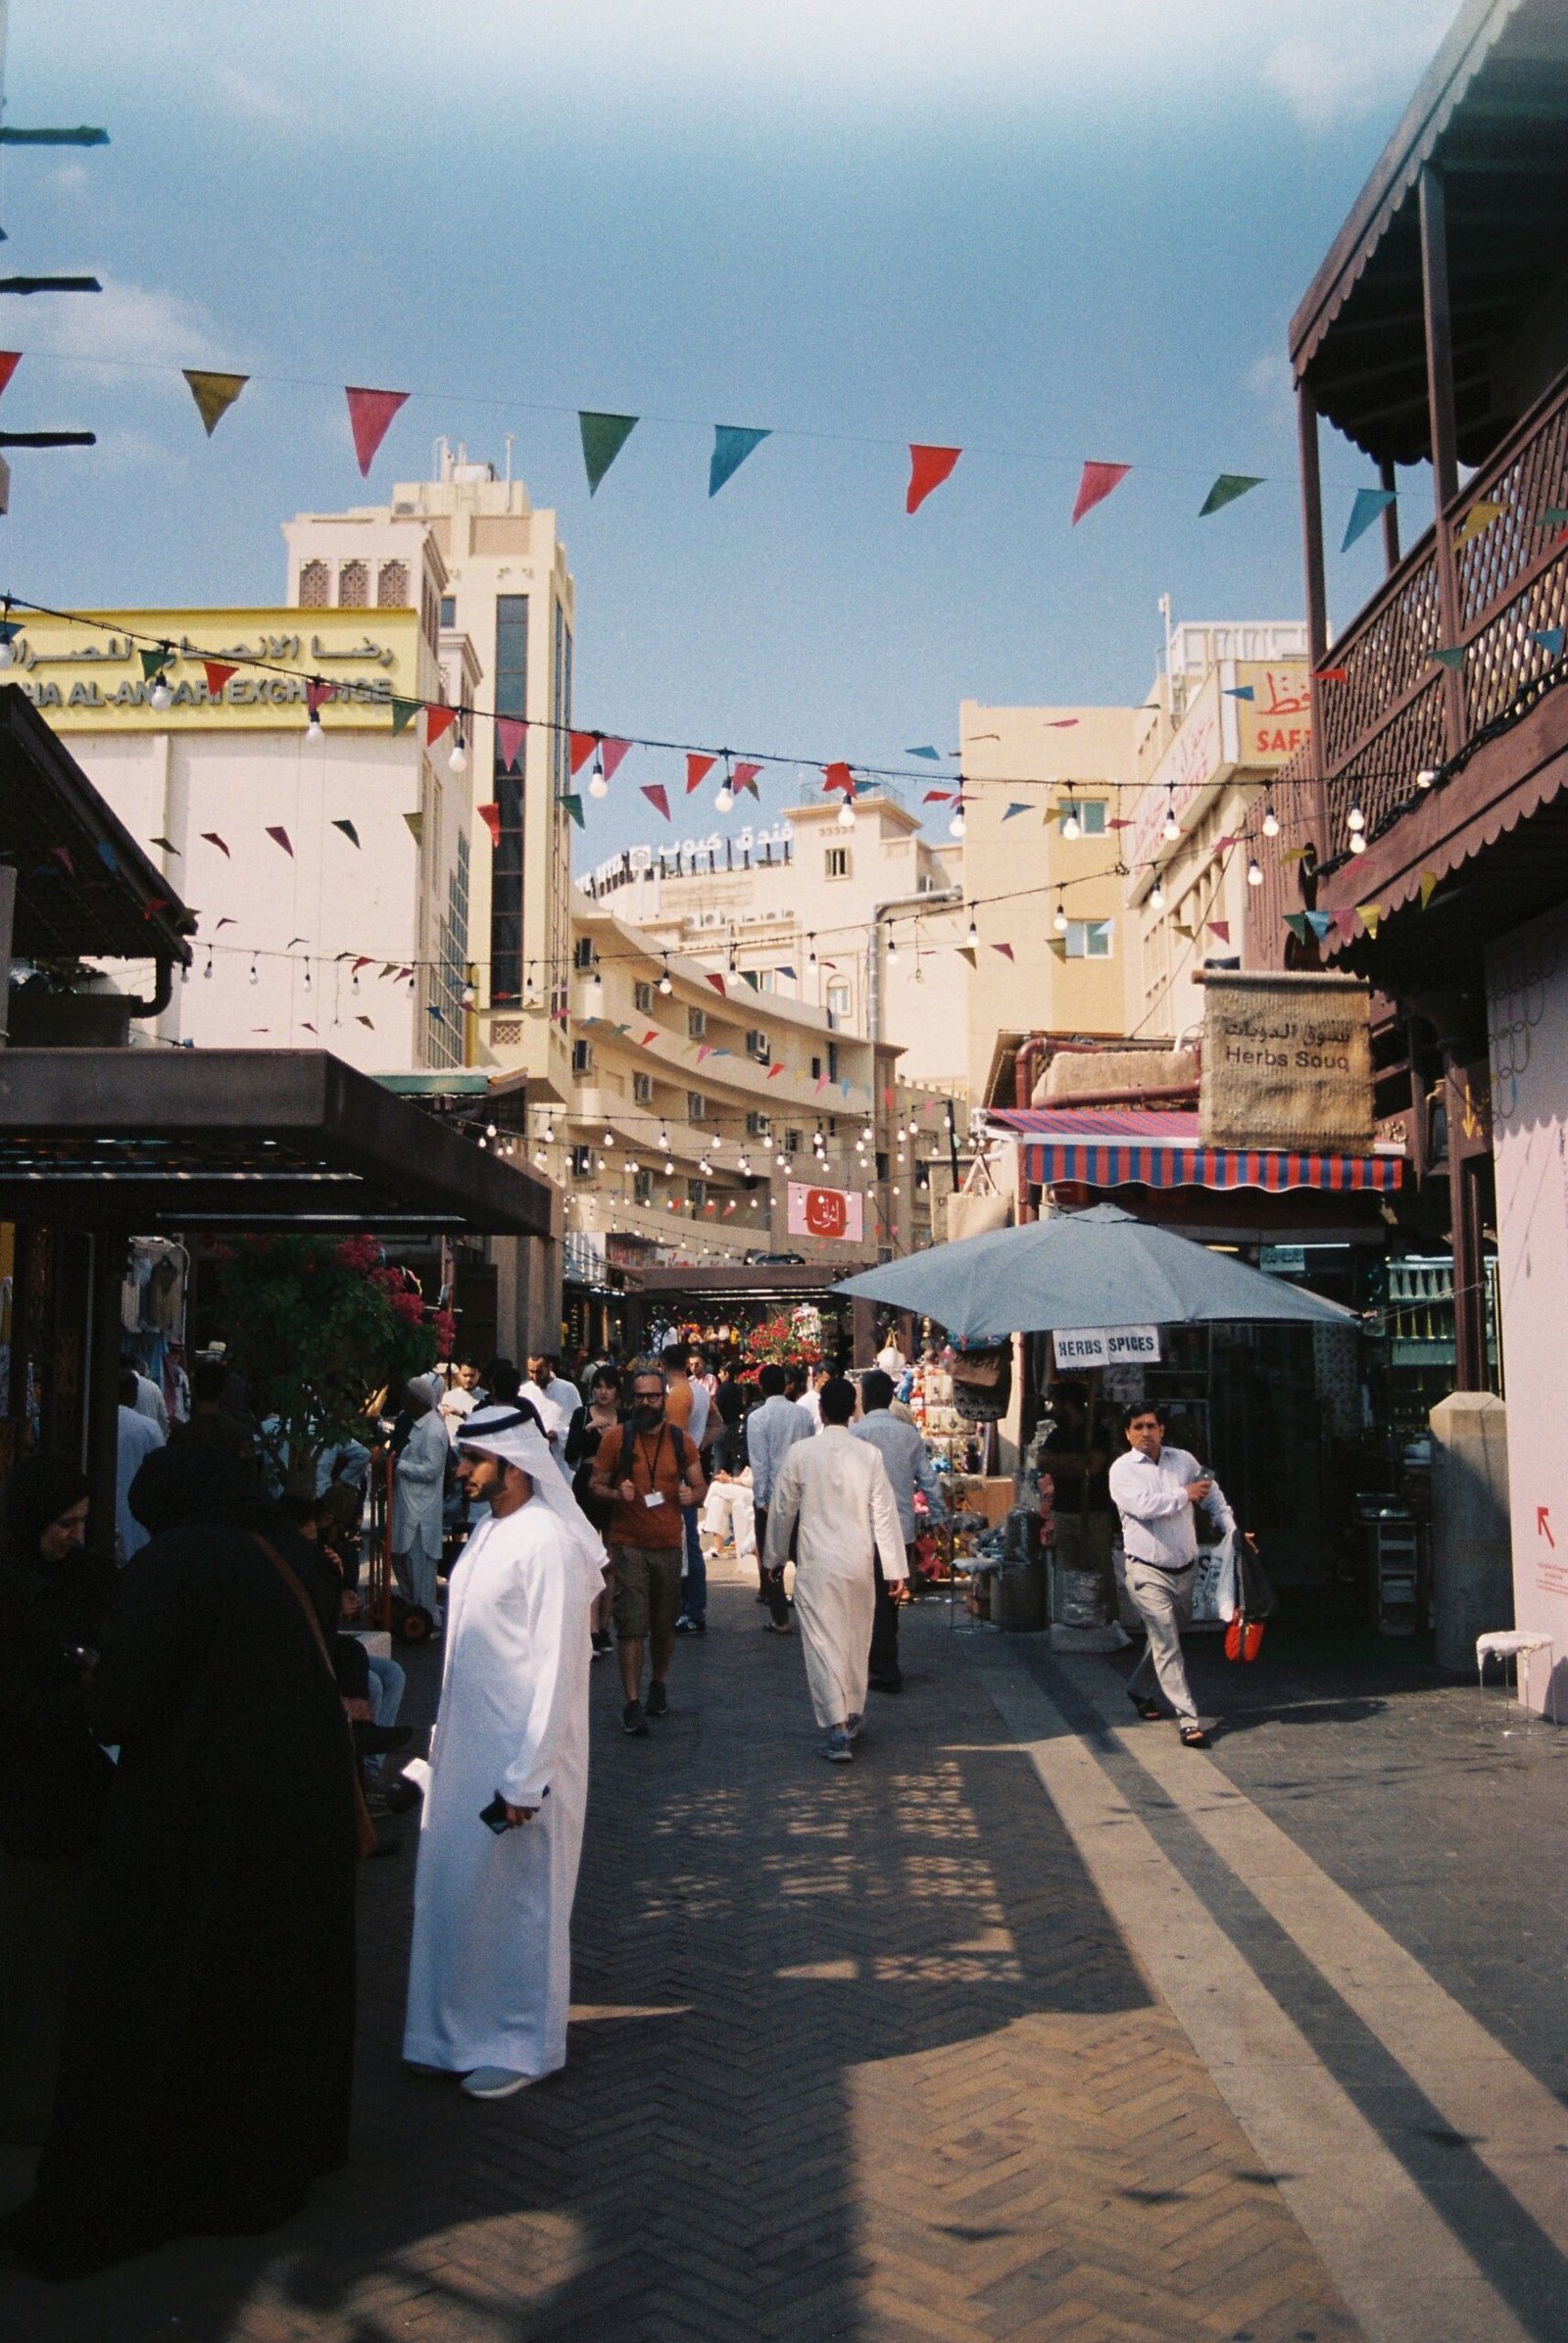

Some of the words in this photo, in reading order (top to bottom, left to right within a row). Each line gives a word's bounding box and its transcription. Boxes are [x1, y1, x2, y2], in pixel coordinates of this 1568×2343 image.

[311, 635, 393, 667] رضا
[228, 678, 391, 705] EXCHNGE
[1256, 728, 1311, 753] SAF
[1226, 1046, 1289, 1067] Herbs
[1296, 1050, 1350, 1073] Souq
[1058, 1340, 1102, 1356] HERBS
[1107, 1336, 1154, 1352] SPICES
